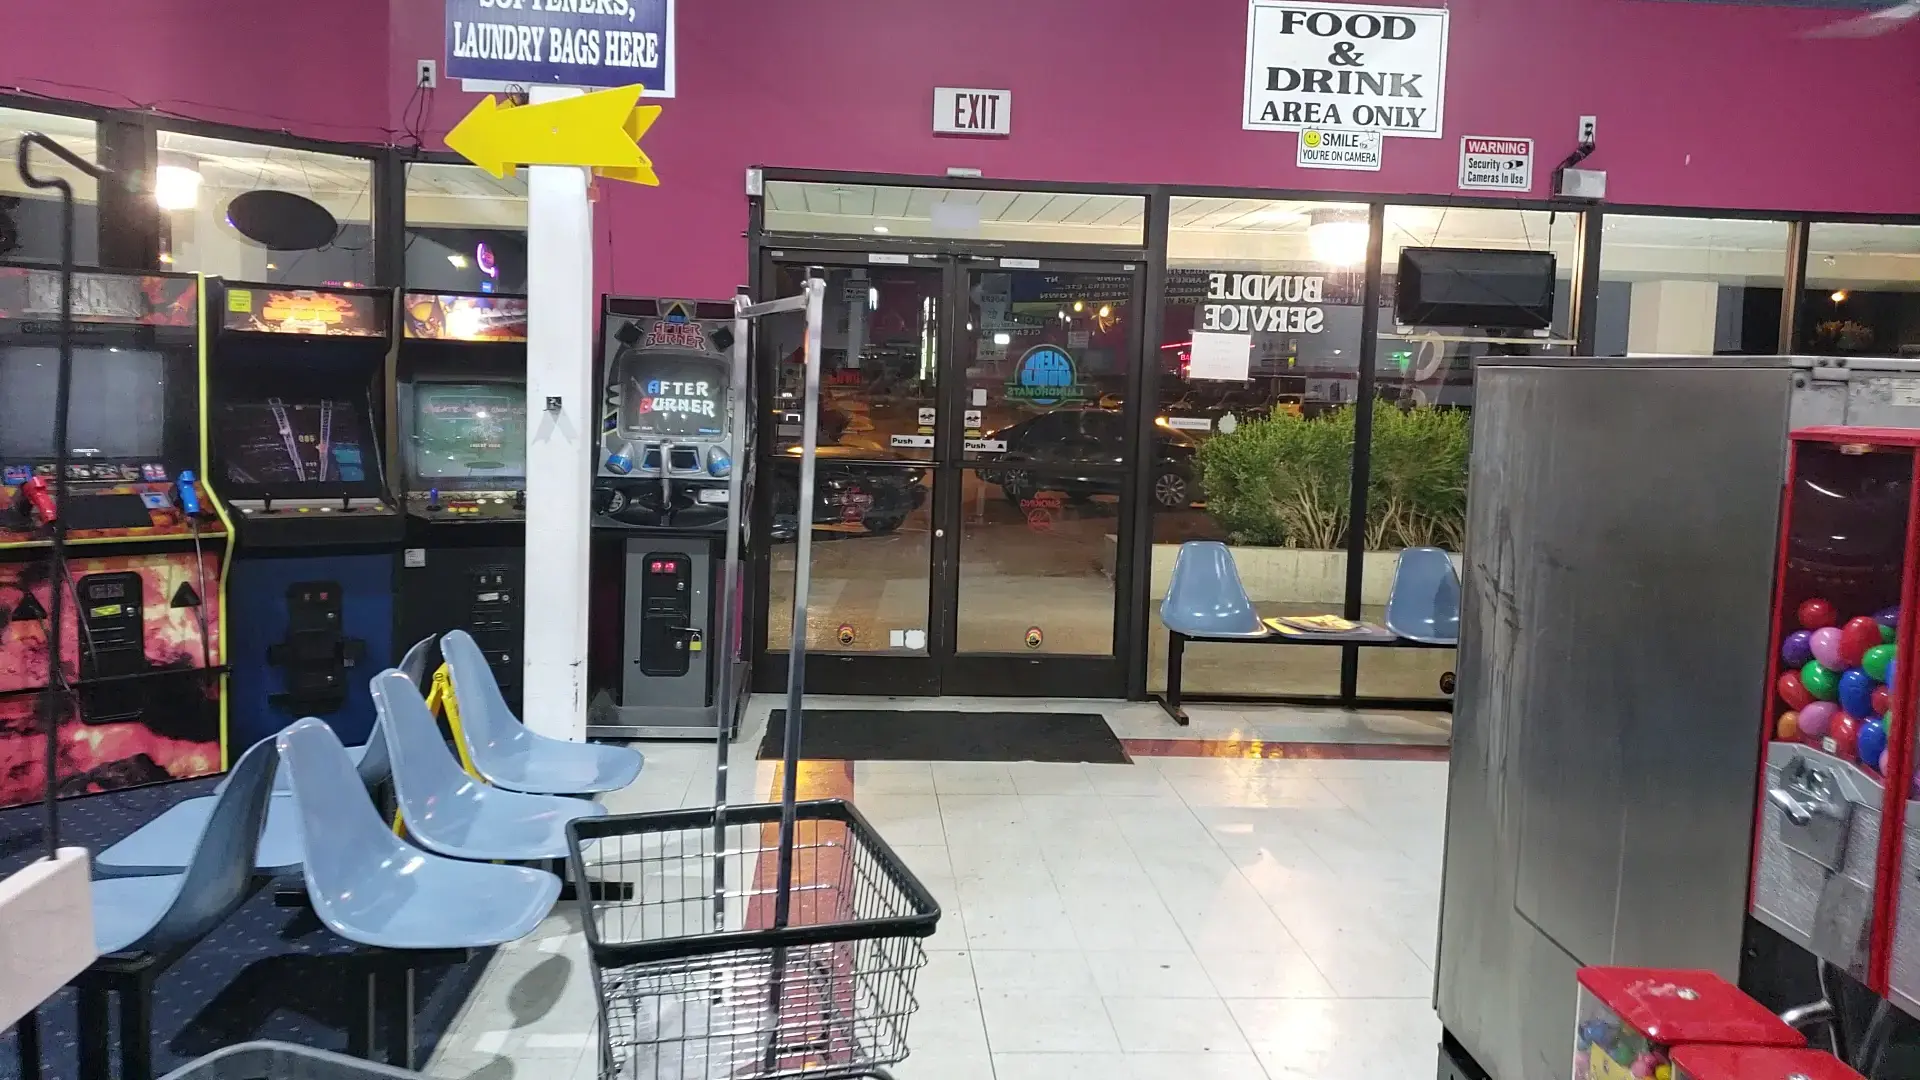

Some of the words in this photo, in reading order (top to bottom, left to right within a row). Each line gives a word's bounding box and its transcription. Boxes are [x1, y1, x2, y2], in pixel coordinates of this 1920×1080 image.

[1279, 10, 1416, 40] FOOD
[453, 21, 545, 62] LAUNDRY
[548, 27, 600, 66] BAGS
[604, 30, 659, 68] HERE
[1328, 41, 1364, 66] &
[1265, 67, 1423, 98] DRINK
[954, 93, 1000, 129] EXIT
[1260, 101, 1342, 124] AREA
[1352, 105, 1427, 128] ONLY
[1322, 133, 1359, 148] SMILE
[1468, 141, 1527, 154] WARNING
[1302, 149, 1330, 161] YOU'RE
[1331, 151, 1343, 161] ON
[1344, 152, 1377, 163] CAMERA
[1468, 157, 1500, 171] Security
[1467, 171, 1499, 183] Cameras
[1501, 173, 1509, 183] In
[1510, 173, 1524, 184] Use
[653, 322, 701, 336] AFTER
[645, 333, 706, 350] BURNER
[647, 380, 709, 397] AFTER
[639, 397, 716, 418] BURNER
